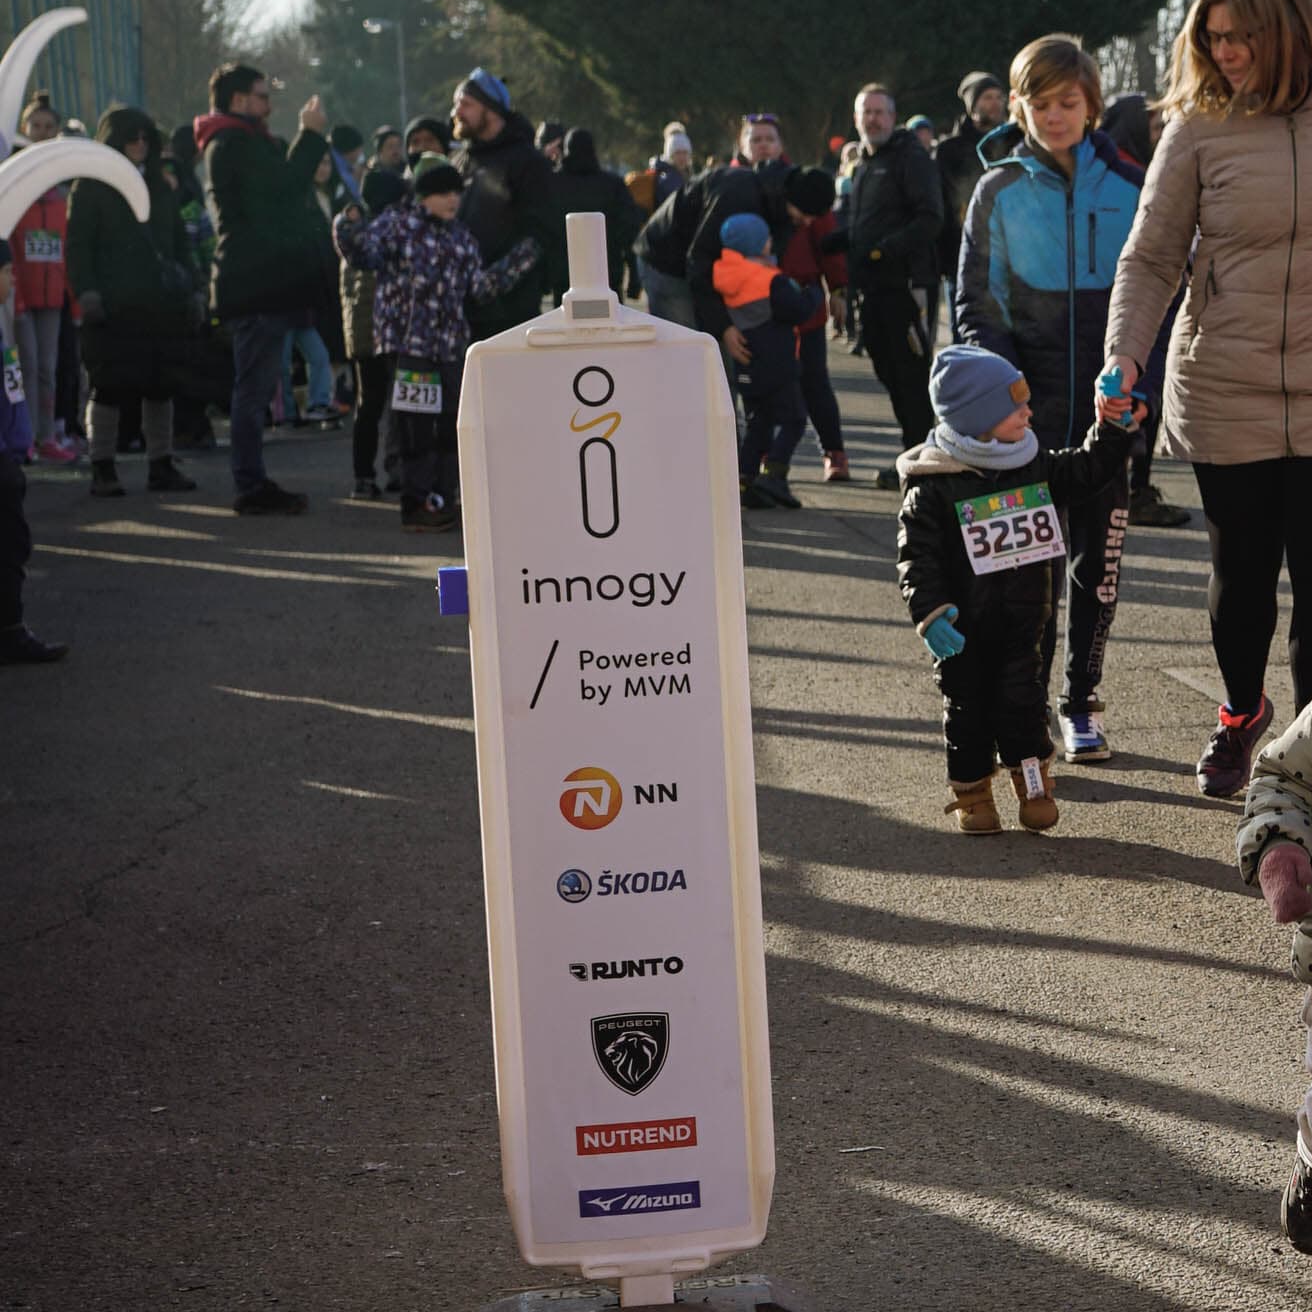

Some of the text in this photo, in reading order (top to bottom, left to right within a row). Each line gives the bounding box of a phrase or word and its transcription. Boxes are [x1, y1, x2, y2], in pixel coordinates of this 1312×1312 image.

[967, 510, 1054, 559] 3258
[521, 568, 686, 607] innogy
[580, 643, 691, 671] Powered
[581, 674, 691, 705] by MVM
[634, 782, 678, 805] NN
[597, 869, 688, 897] ŠKODA
[591, 956, 684, 981] RUNTO
[598, 1019, 662, 1031] PEUGEOT
[583, 1124, 692, 1149] NUTREND
